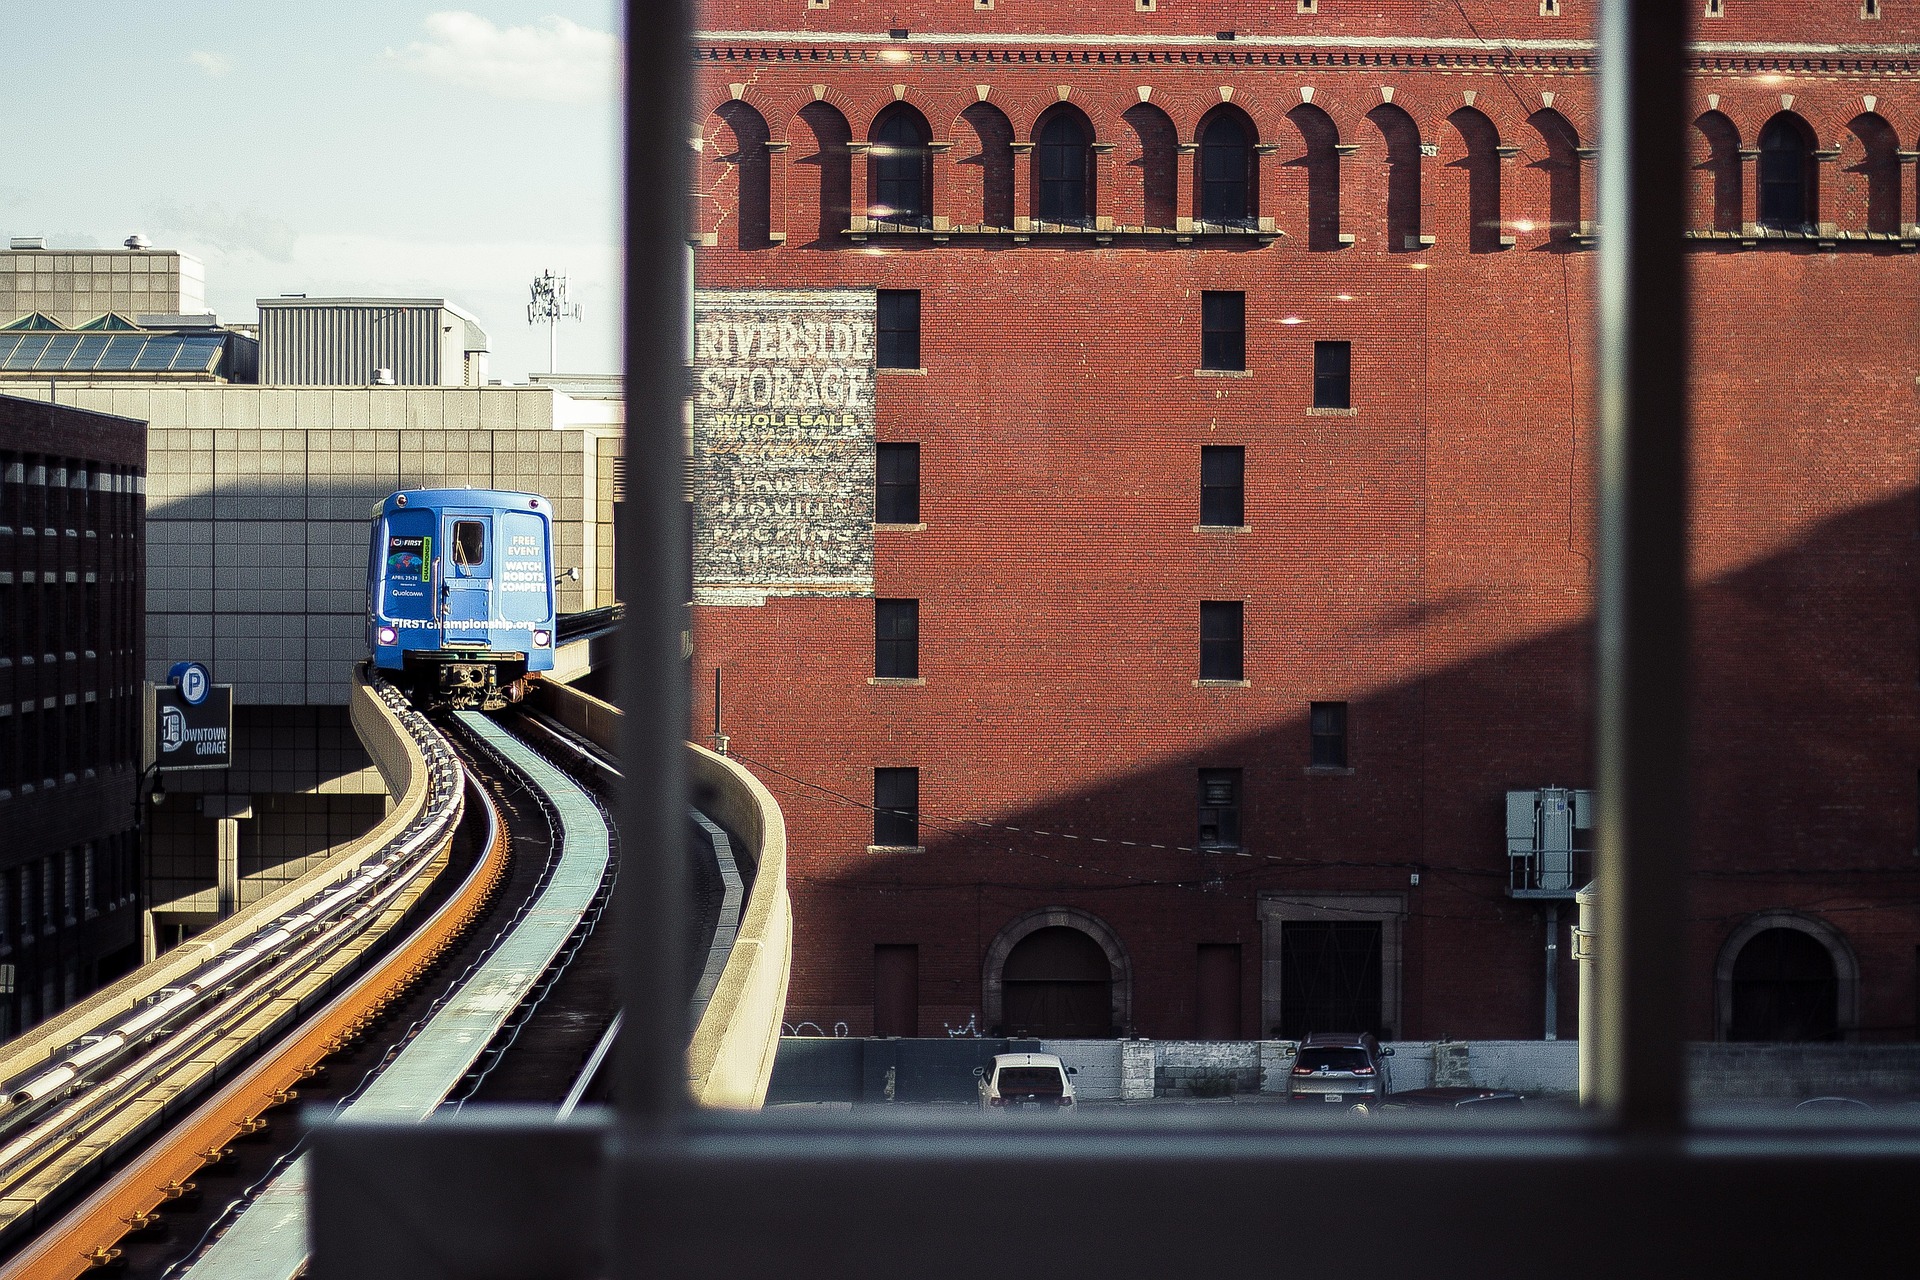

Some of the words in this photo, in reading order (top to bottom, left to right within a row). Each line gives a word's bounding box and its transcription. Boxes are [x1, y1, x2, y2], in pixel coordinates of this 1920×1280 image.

[695, 321, 873, 360] RIVERSIDE
[700, 366, 869, 408] STORAGE
[715, 414, 856, 427] WHOLESALE
[512, 536, 536, 545] FREE
[508, 546, 540, 556] EVENT
[505, 561, 542, 571] WATCH
[503, 571, 545, 581] ROBOTS
[501, 582, 547, 593] COMPETE
[188, 672, 201, 696] P
[195, 741, 227, 755] GARAGE
